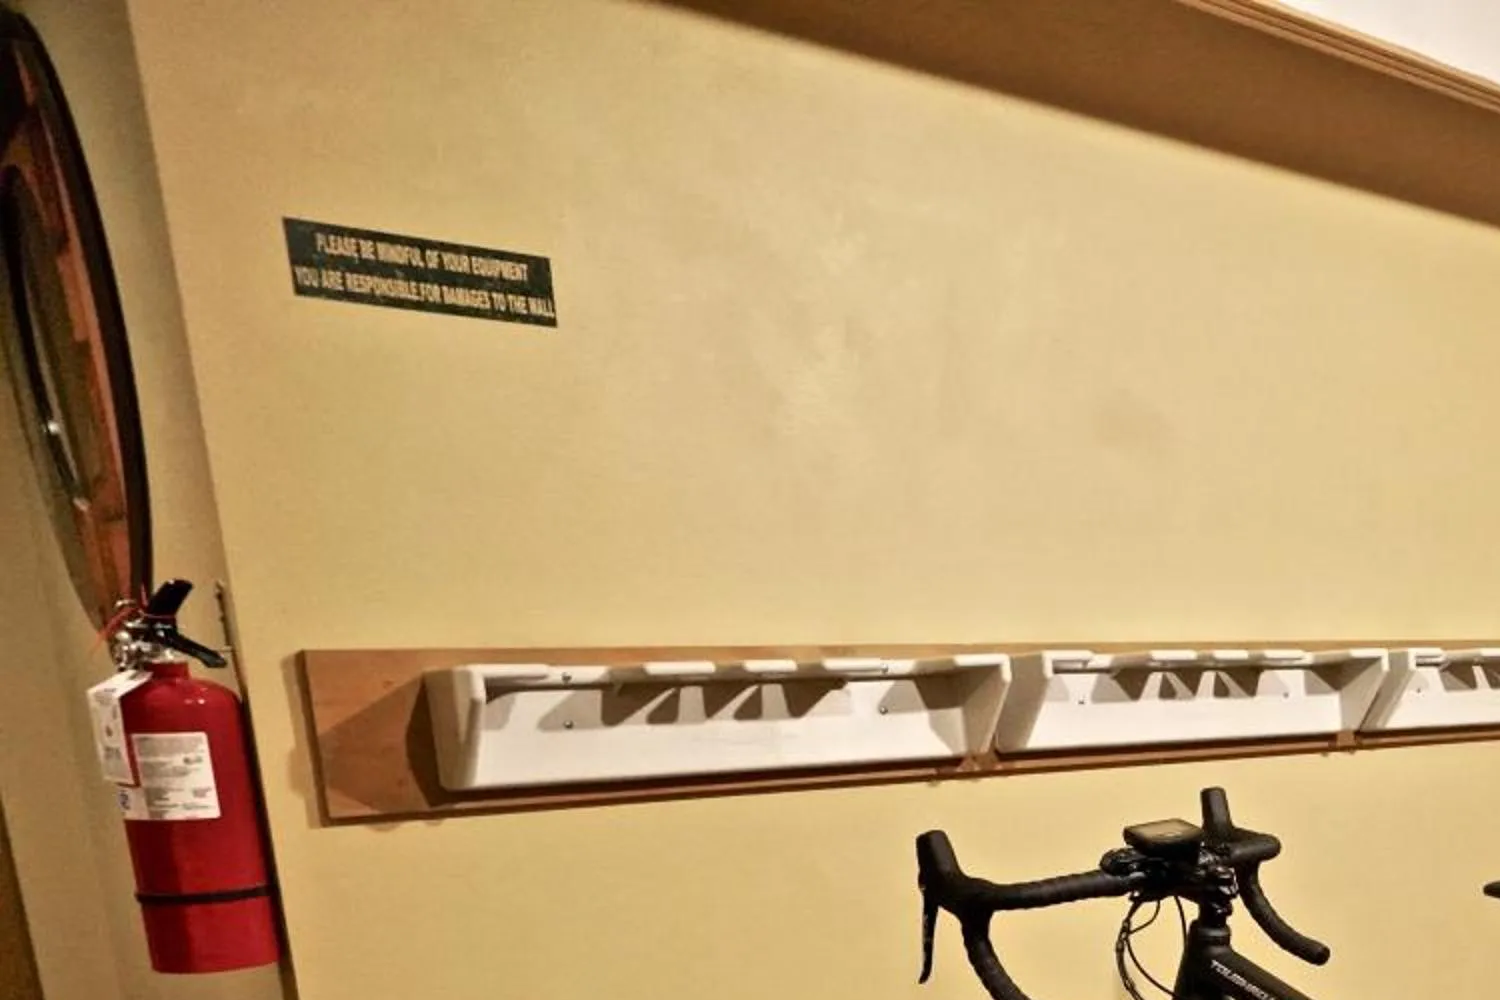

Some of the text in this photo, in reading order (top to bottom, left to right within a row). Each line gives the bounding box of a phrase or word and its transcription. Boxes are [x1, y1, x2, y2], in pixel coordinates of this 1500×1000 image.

[315, 232, 358, 258] PLEASE
[358, 239, 376, 260] BE
[424, 248, 440, 270] OF
[440, 251, 470, 275] YOUR
[470, 255, 529, 281] EQUIPMENT
[293, 265, 320, 289] YOU
[320, 268, 345, 291] ARE
[344, 271, 420, 301] RESPONSIBLE
[420, 281, 441, 303] FOR
[440, 284, 492, 310] DAMAGES
[491, 291, 506, 312] TO
[505, 293, 528, 315] THE
